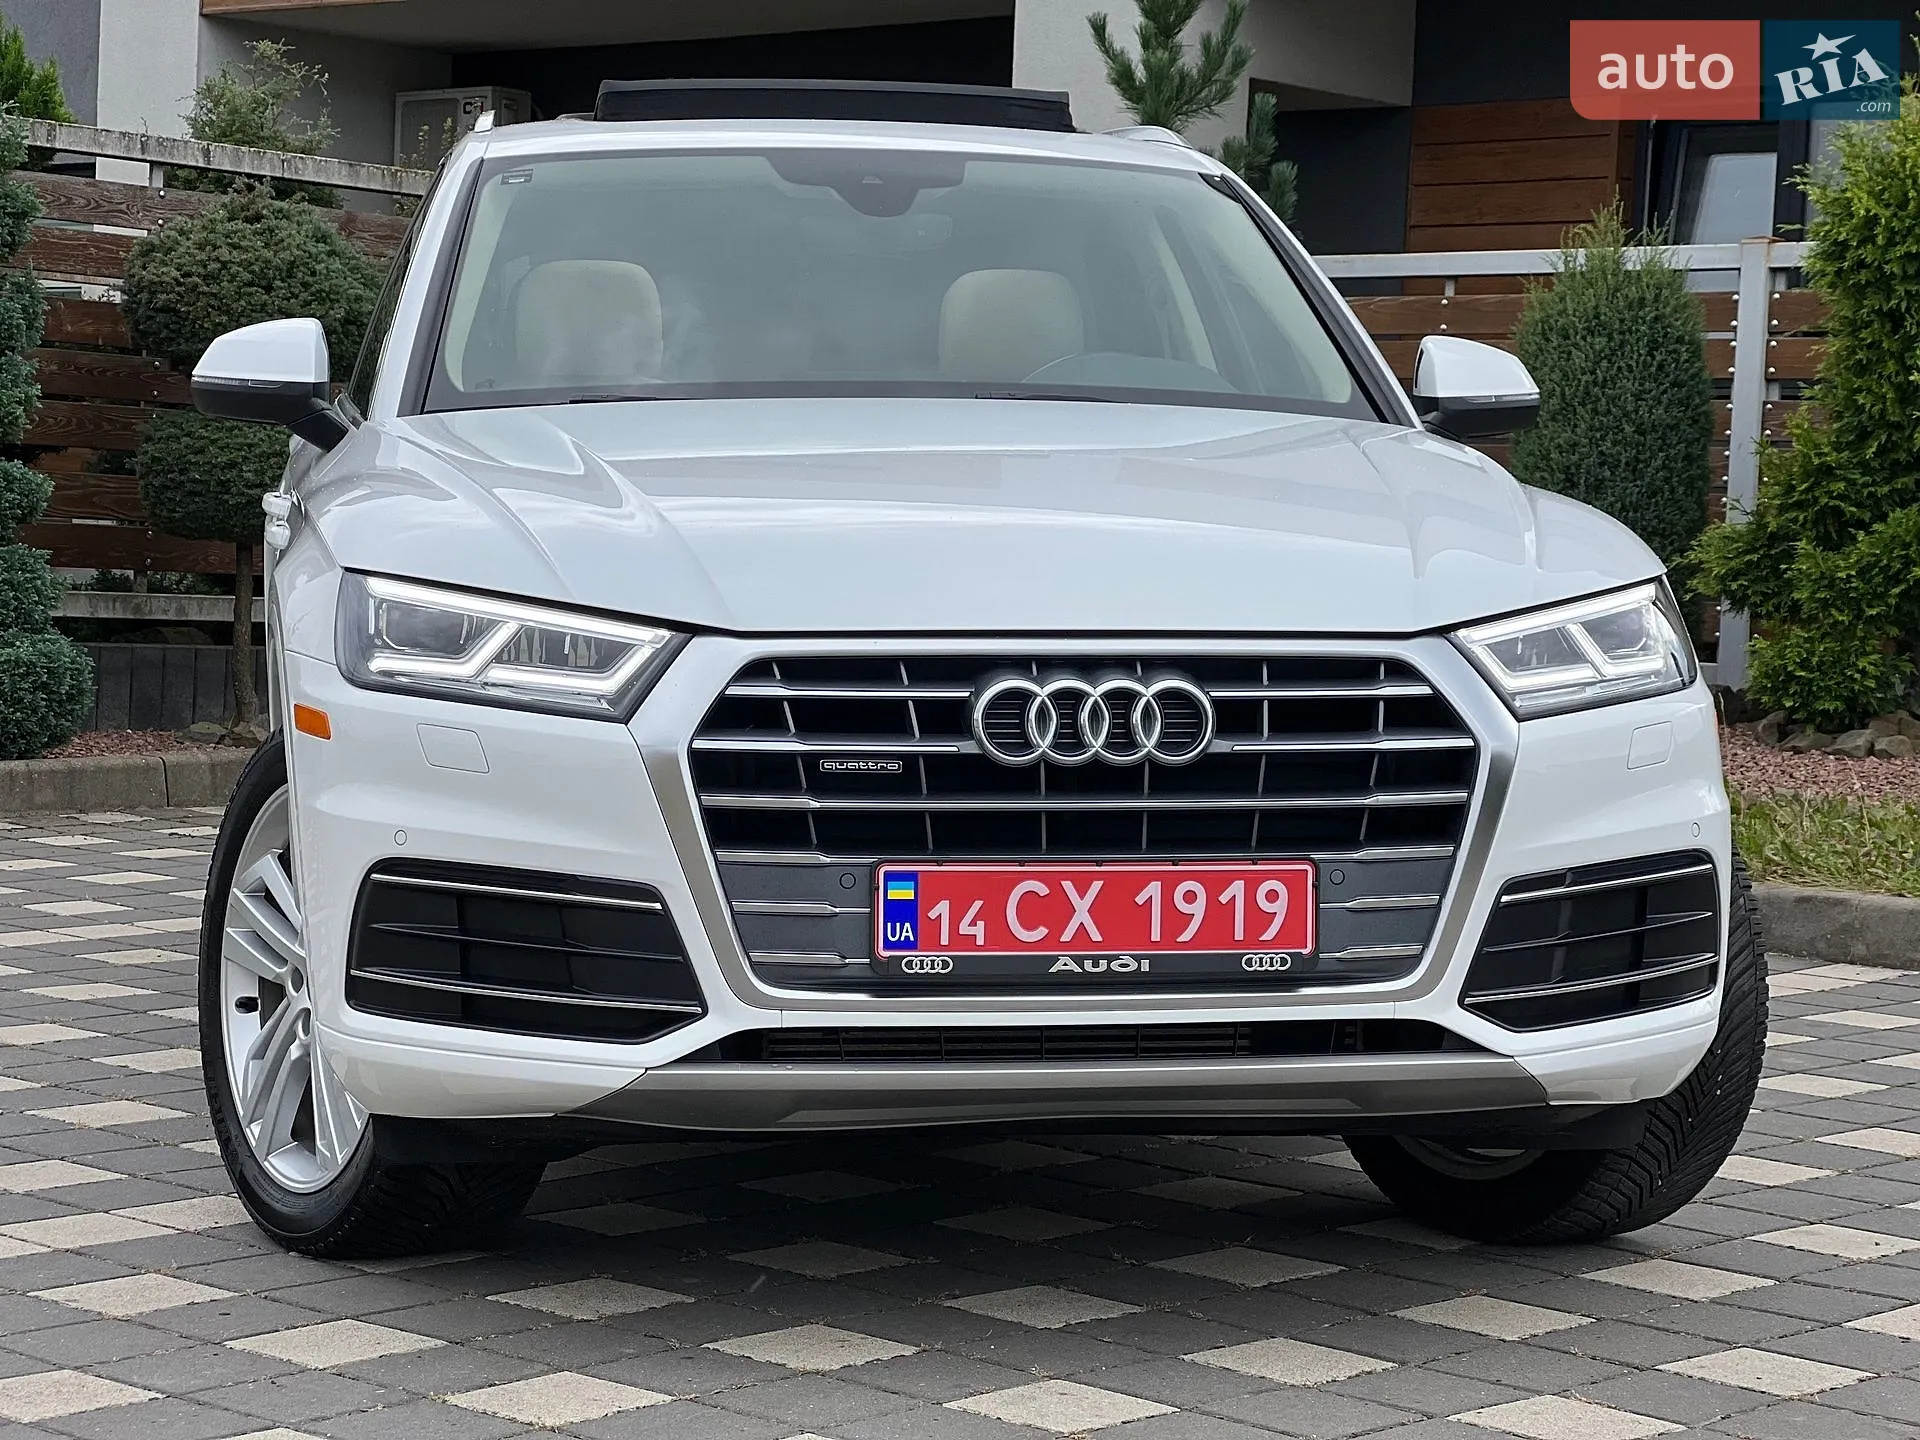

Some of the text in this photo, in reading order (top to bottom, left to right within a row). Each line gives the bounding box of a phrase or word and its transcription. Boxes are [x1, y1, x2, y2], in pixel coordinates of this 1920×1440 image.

[823, 761, 899, 771] quattro
[886, 879, 1289, 946] UA 14 CX 1919
[1048, 955, 1150, 972] Audi
